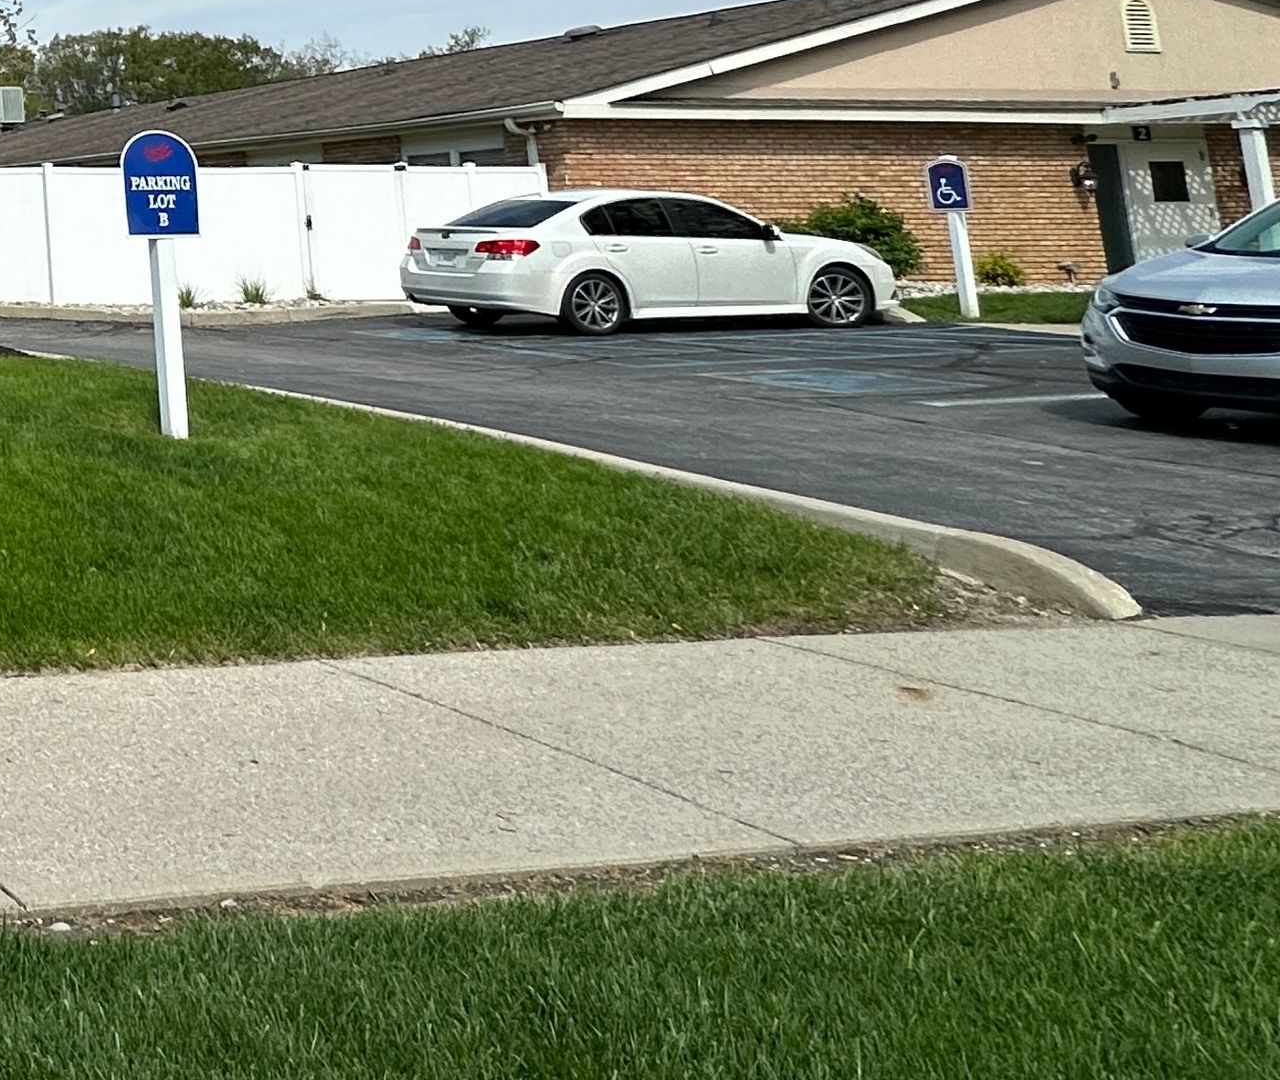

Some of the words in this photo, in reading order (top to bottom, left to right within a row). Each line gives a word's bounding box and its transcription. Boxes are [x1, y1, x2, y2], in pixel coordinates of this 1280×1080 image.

[1138, 127, 1148, 140] 2
[130, 176, 191, 191] PARKING
[148, 194, 176, 209] LOT
[158, 212, 169, 227] B
